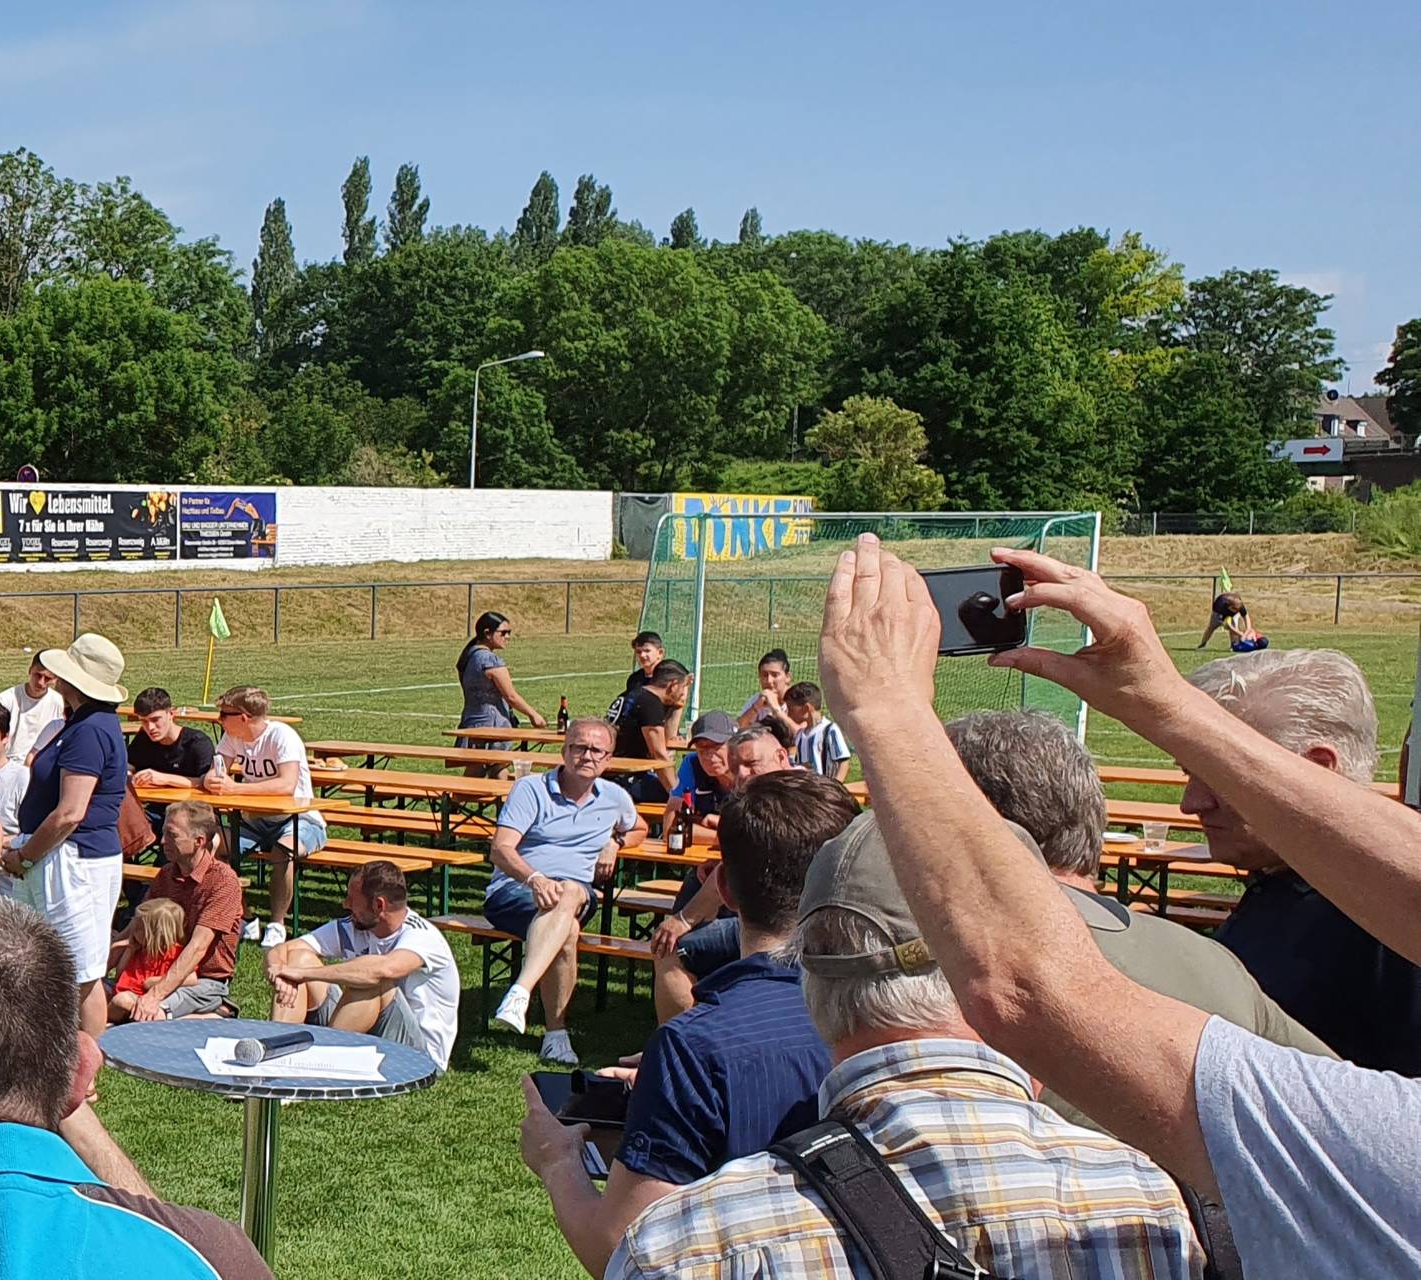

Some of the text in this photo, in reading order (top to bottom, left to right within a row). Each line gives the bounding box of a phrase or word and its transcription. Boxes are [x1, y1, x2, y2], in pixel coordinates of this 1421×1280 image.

[9, 493, 28, 514] Wir
[18, 520, 104, 532] 7 x für Sie in Ihrer Nähe
